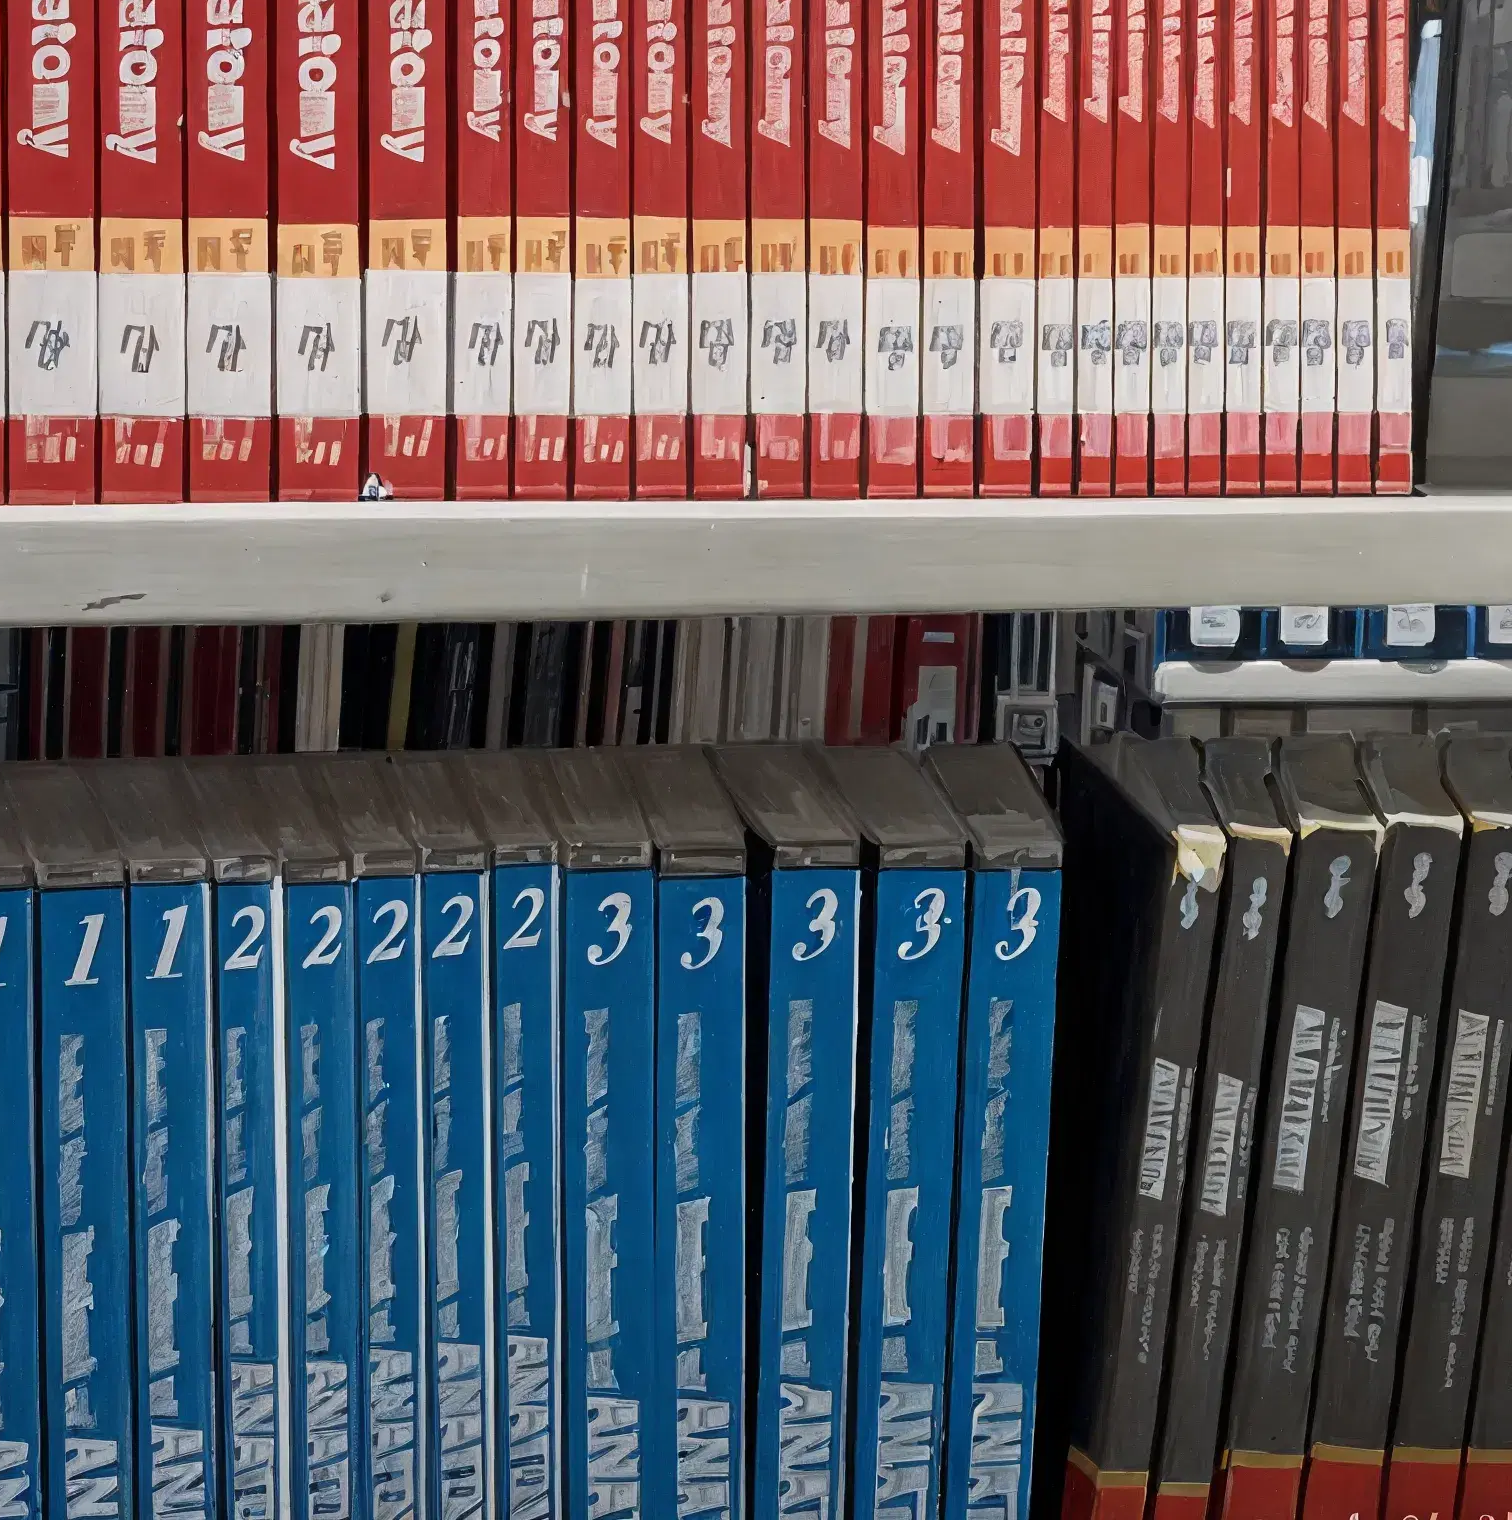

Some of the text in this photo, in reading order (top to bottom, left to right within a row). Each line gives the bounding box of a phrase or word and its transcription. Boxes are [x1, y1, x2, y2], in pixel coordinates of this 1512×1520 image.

[65, 913, 105, 985] 1
[146, 905, 188, 979] 1
[225, 906, 264, 970] 2
[303, 906, 342, 968] 2
[368, 900, 408, 964] 2
[433, 896, 474, 958] 2
[504, 888, 545, 949] 2
[587, 892, 632, 965] 3
[680, 897, 724, 970] 3
[792, 888, 839, 961] 3
[898, 887, 946, 961] 3
[995, 887, 1042, 961] 3
